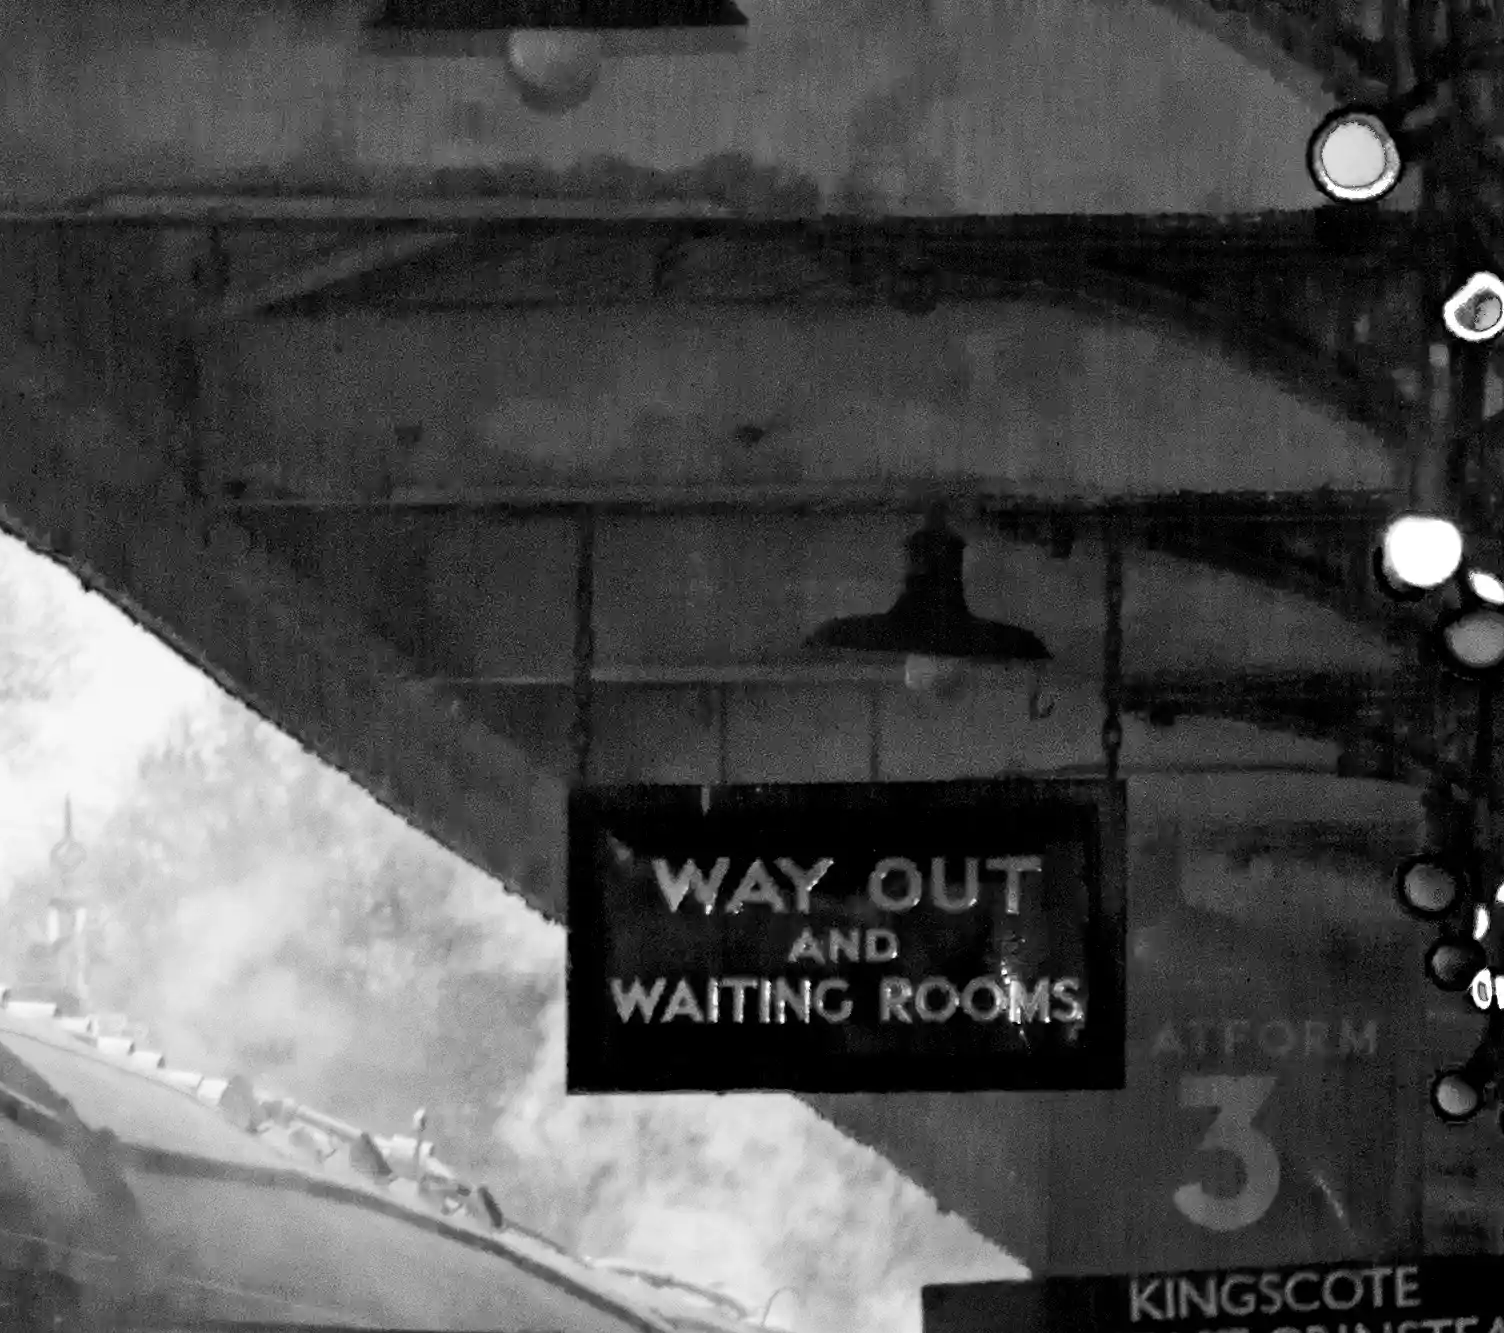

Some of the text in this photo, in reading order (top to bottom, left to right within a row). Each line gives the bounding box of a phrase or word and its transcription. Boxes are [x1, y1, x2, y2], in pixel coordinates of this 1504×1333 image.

[652, 856, 1043, 915] WAY OUT
[788, 928, 900, 963] AND
[609, 976, 1085, 1026] WAITING ROOMS
[1150, 1017, 1378, 1058] ATFORM
[1173, 1075, 1281, 1232] 3
[1127, 1264, 1424, 1324] KINGSCOTE
